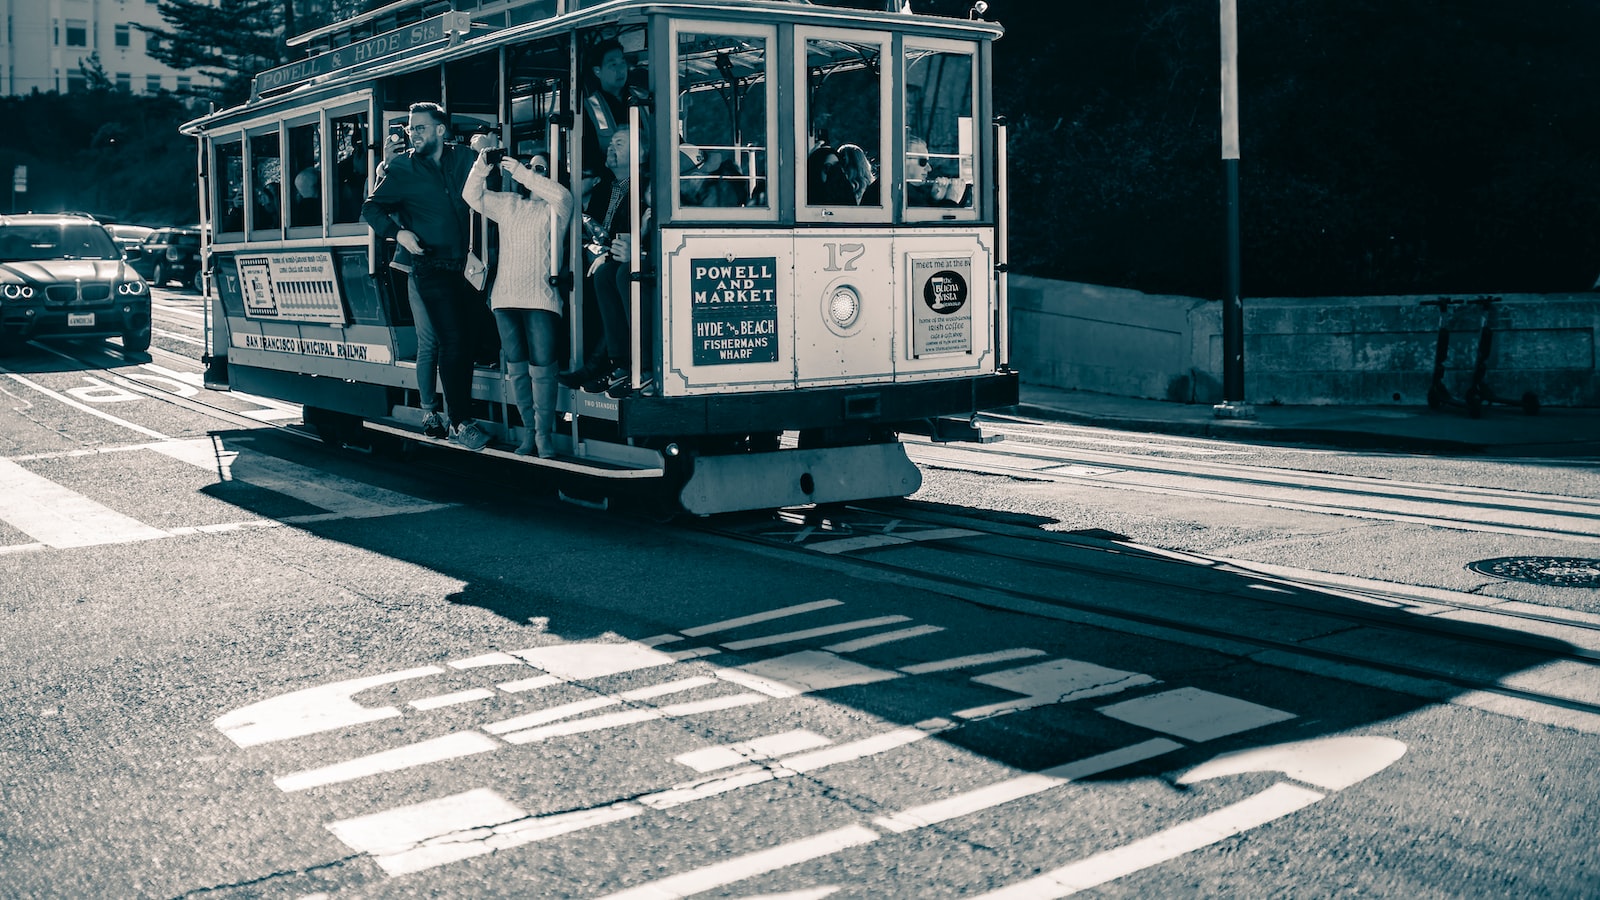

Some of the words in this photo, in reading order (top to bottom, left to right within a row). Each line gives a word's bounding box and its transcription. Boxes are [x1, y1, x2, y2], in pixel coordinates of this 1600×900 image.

[262, 60, 321, 88] POWELL
[332, 53, 342, 68] &
[355, 34, 400, 63] HYDE
[410, 25, 438, 44] Sts.
[823, 243, 866, 271] 17
[934, 260, 944, 268] me
[953, 259, 963, 267] the
[696, 265, 772, 280] POWELL
[226, 275, 236, 293] 17
[716, 279, 754, 290] AND
[695, 289, 774, 304] MARKET
[697, 321, 724, 337] HYDE
[726, 321, 740, 336] AND
[741, 319, 775, 335] BEACH
[246, 335, 259, 348] SAN
[703, 337, 768, 350] FISHERMANS
[719, 349, 753, 360] WHARF
[584, 400, 595, 408] TWO
